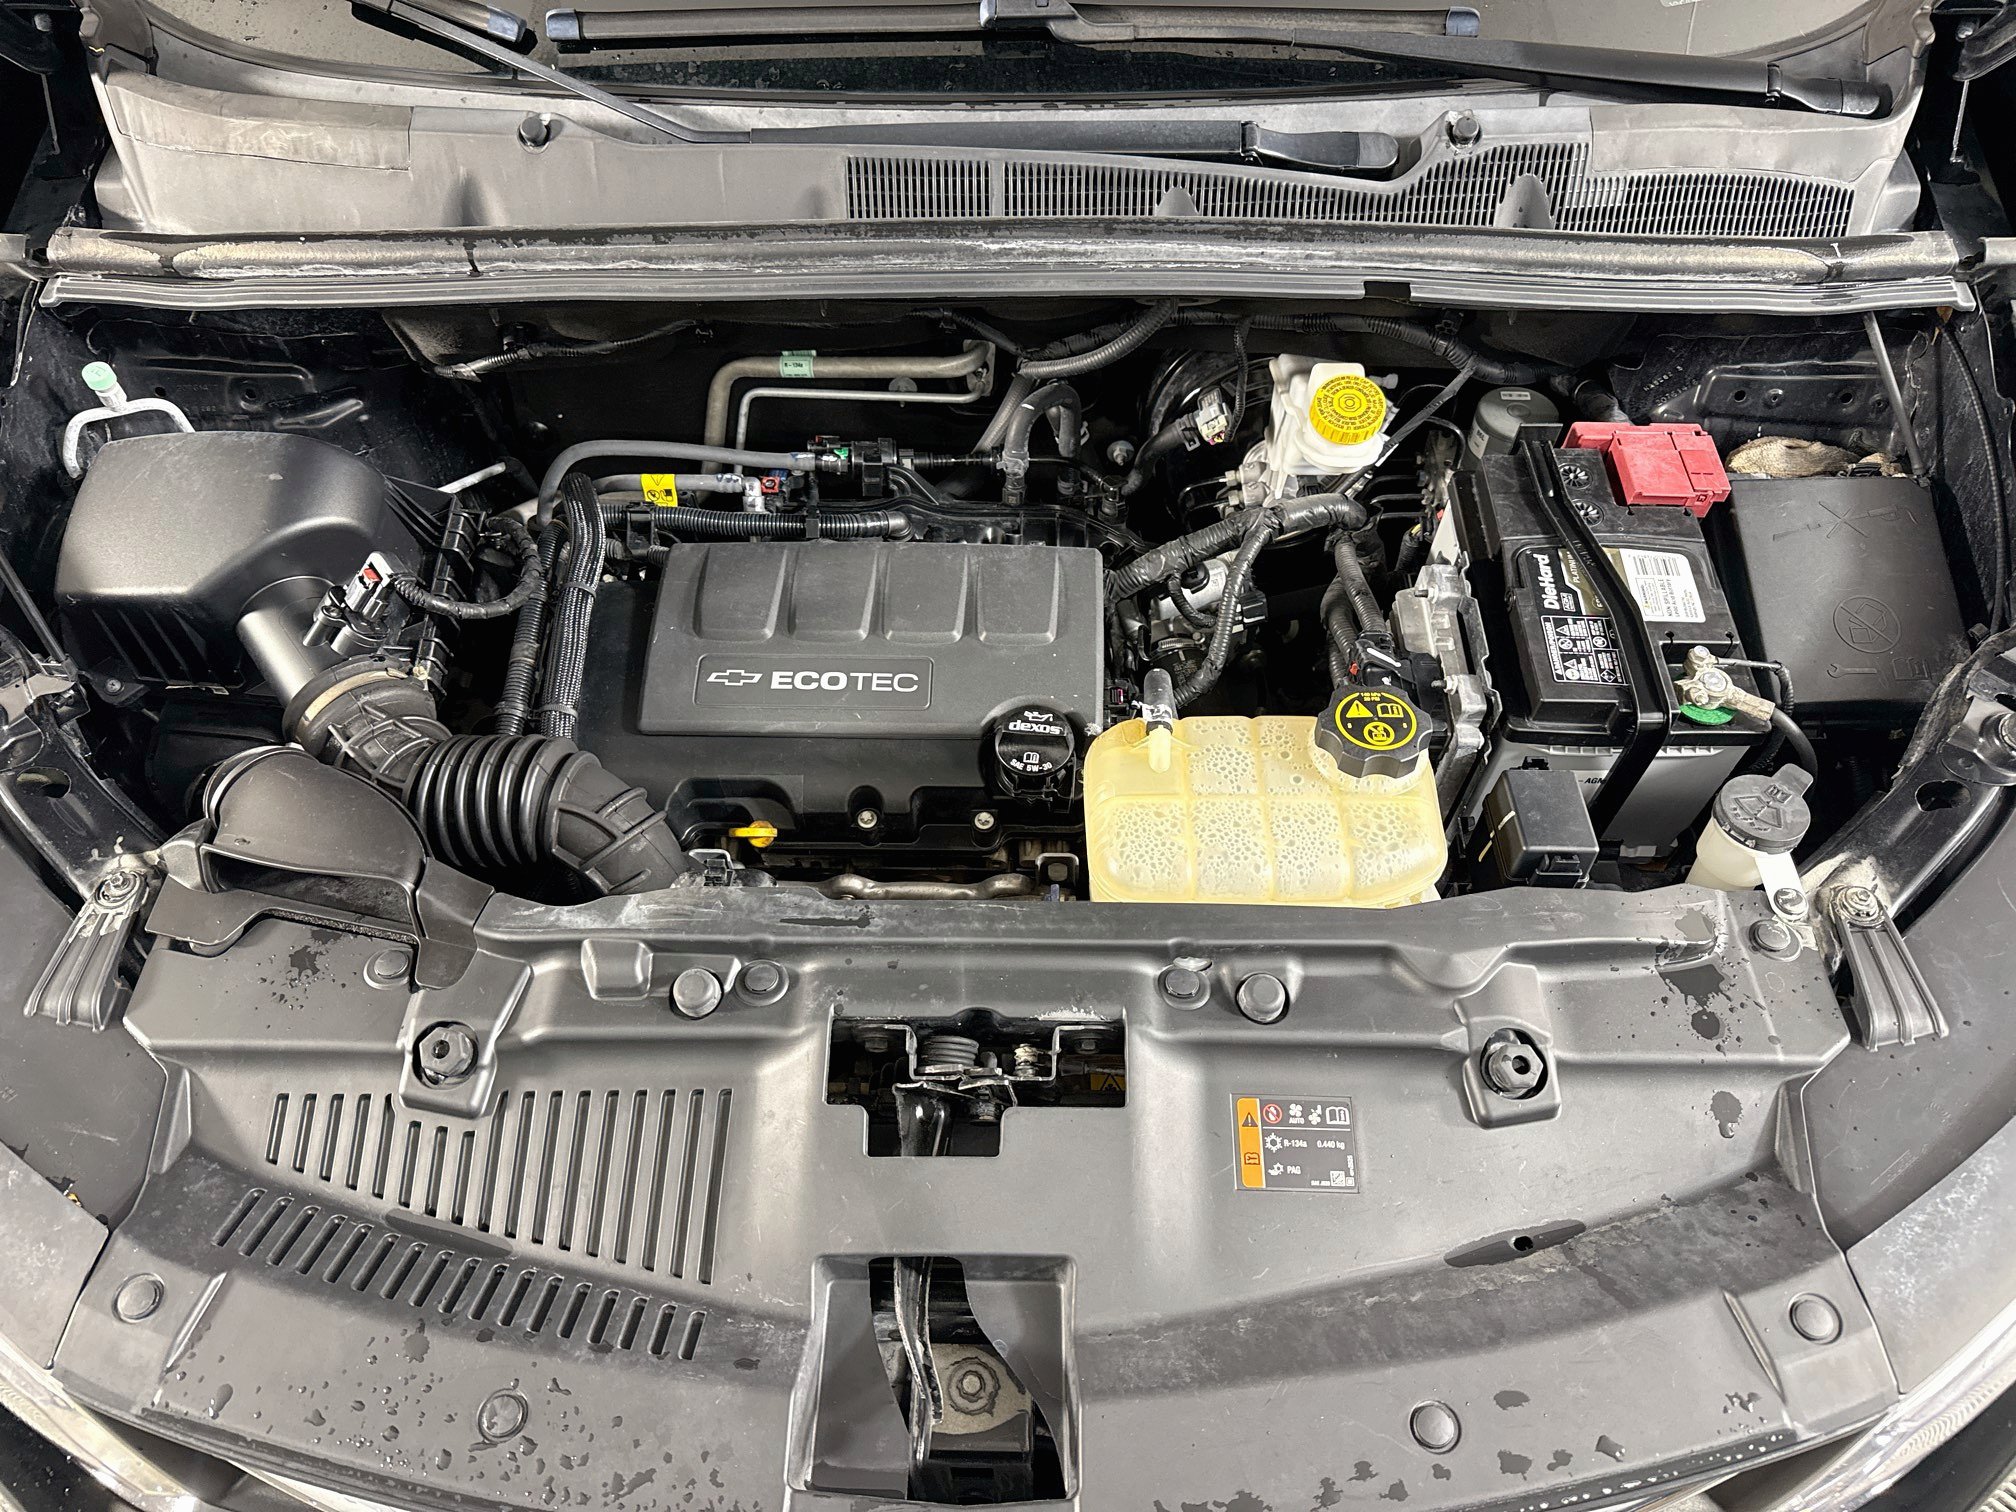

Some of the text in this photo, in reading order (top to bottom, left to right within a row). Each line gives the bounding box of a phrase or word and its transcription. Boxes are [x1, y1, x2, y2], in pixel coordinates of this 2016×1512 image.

[1532, 553, 1560, 610] DieHard
[770, 671, 919, 693] ECOTEC
[1008, 720, 1063, 735] dexos
[1010, 758, 1052, 772] SAE 5W-30
[1283, 1139, 1345, 1150] R-134a 0.440 kg
[1287, 1166, 1301, 1174] PAG
